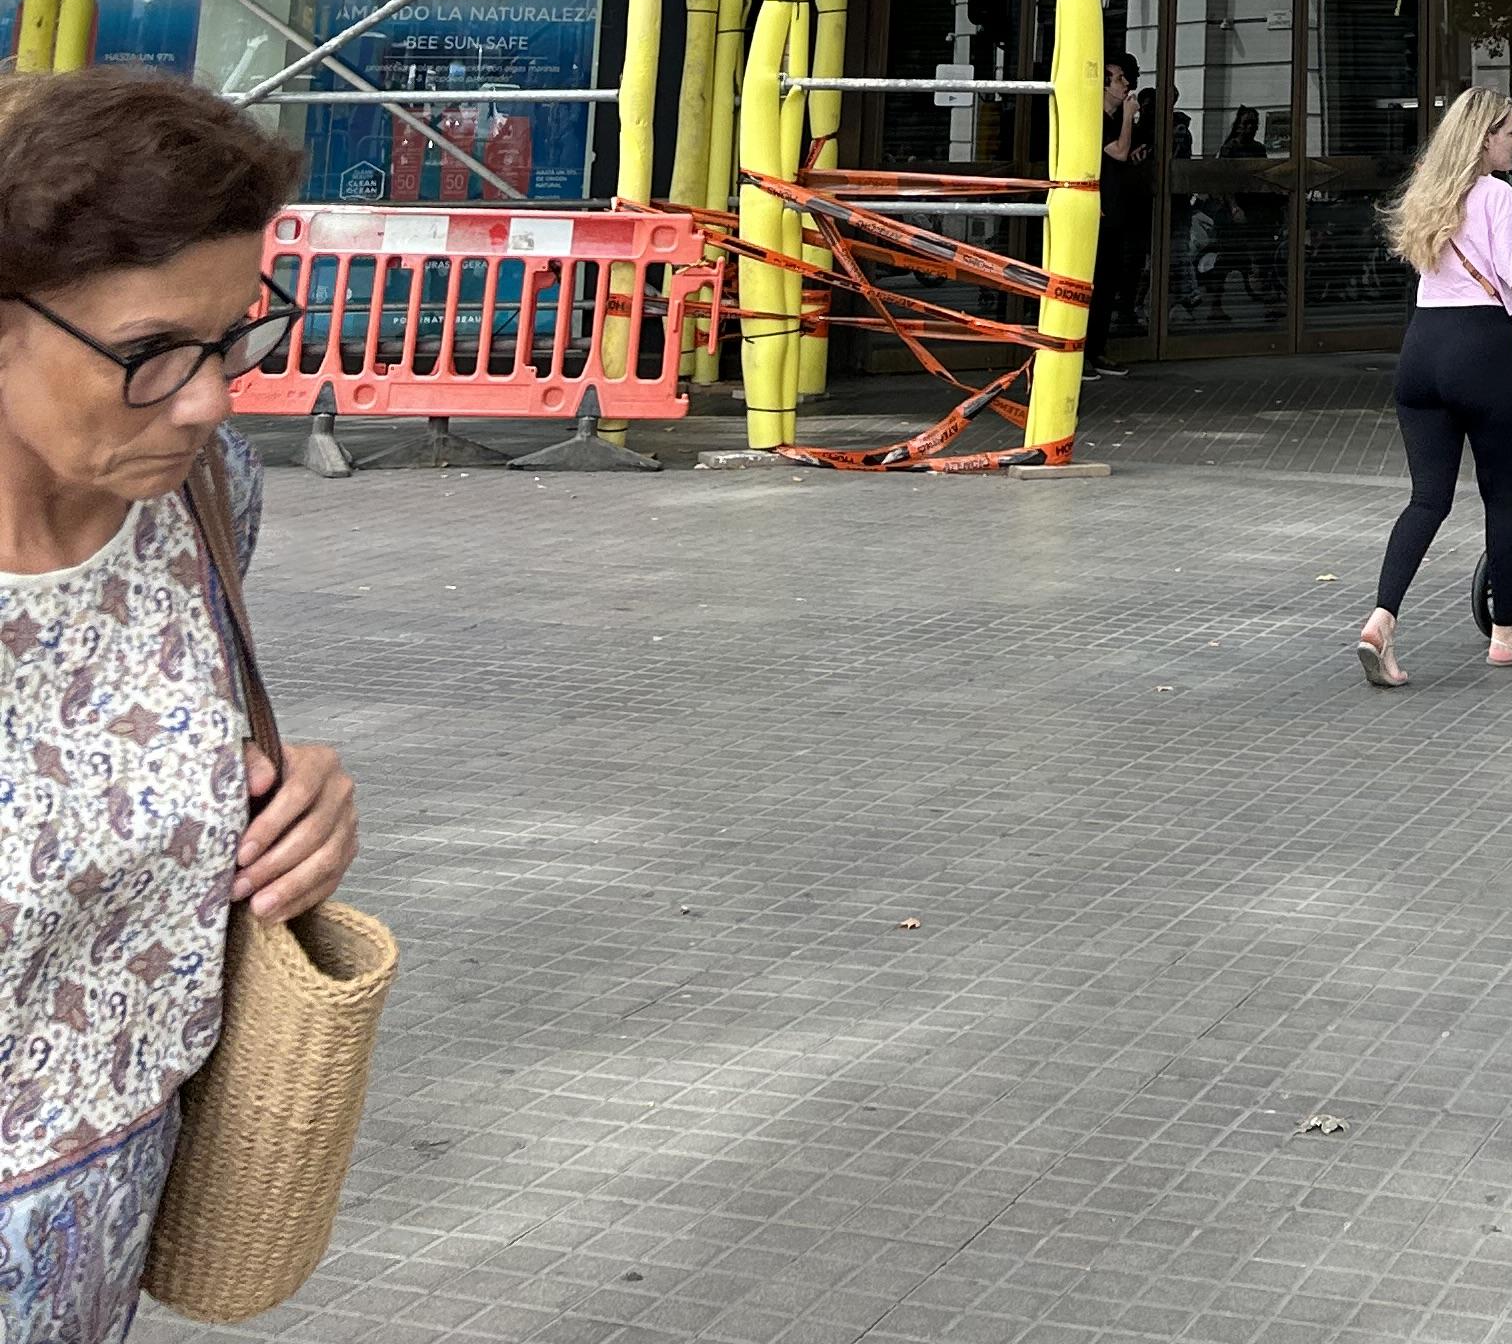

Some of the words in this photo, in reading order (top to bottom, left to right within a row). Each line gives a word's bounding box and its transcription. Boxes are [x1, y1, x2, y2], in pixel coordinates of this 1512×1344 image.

[437, 6, 463, 21] LA
[469, 6, 598, 23] NATURALEZA
[406, 35, 438, 51] BEE
[443, 35, 481, 51] SUN
[486, 36, 529, 51] SAFE
[347, 180, 377, 188] CLEAN
[397, 174, 416, 190] 50
[446, 174, 464, 189] 50
